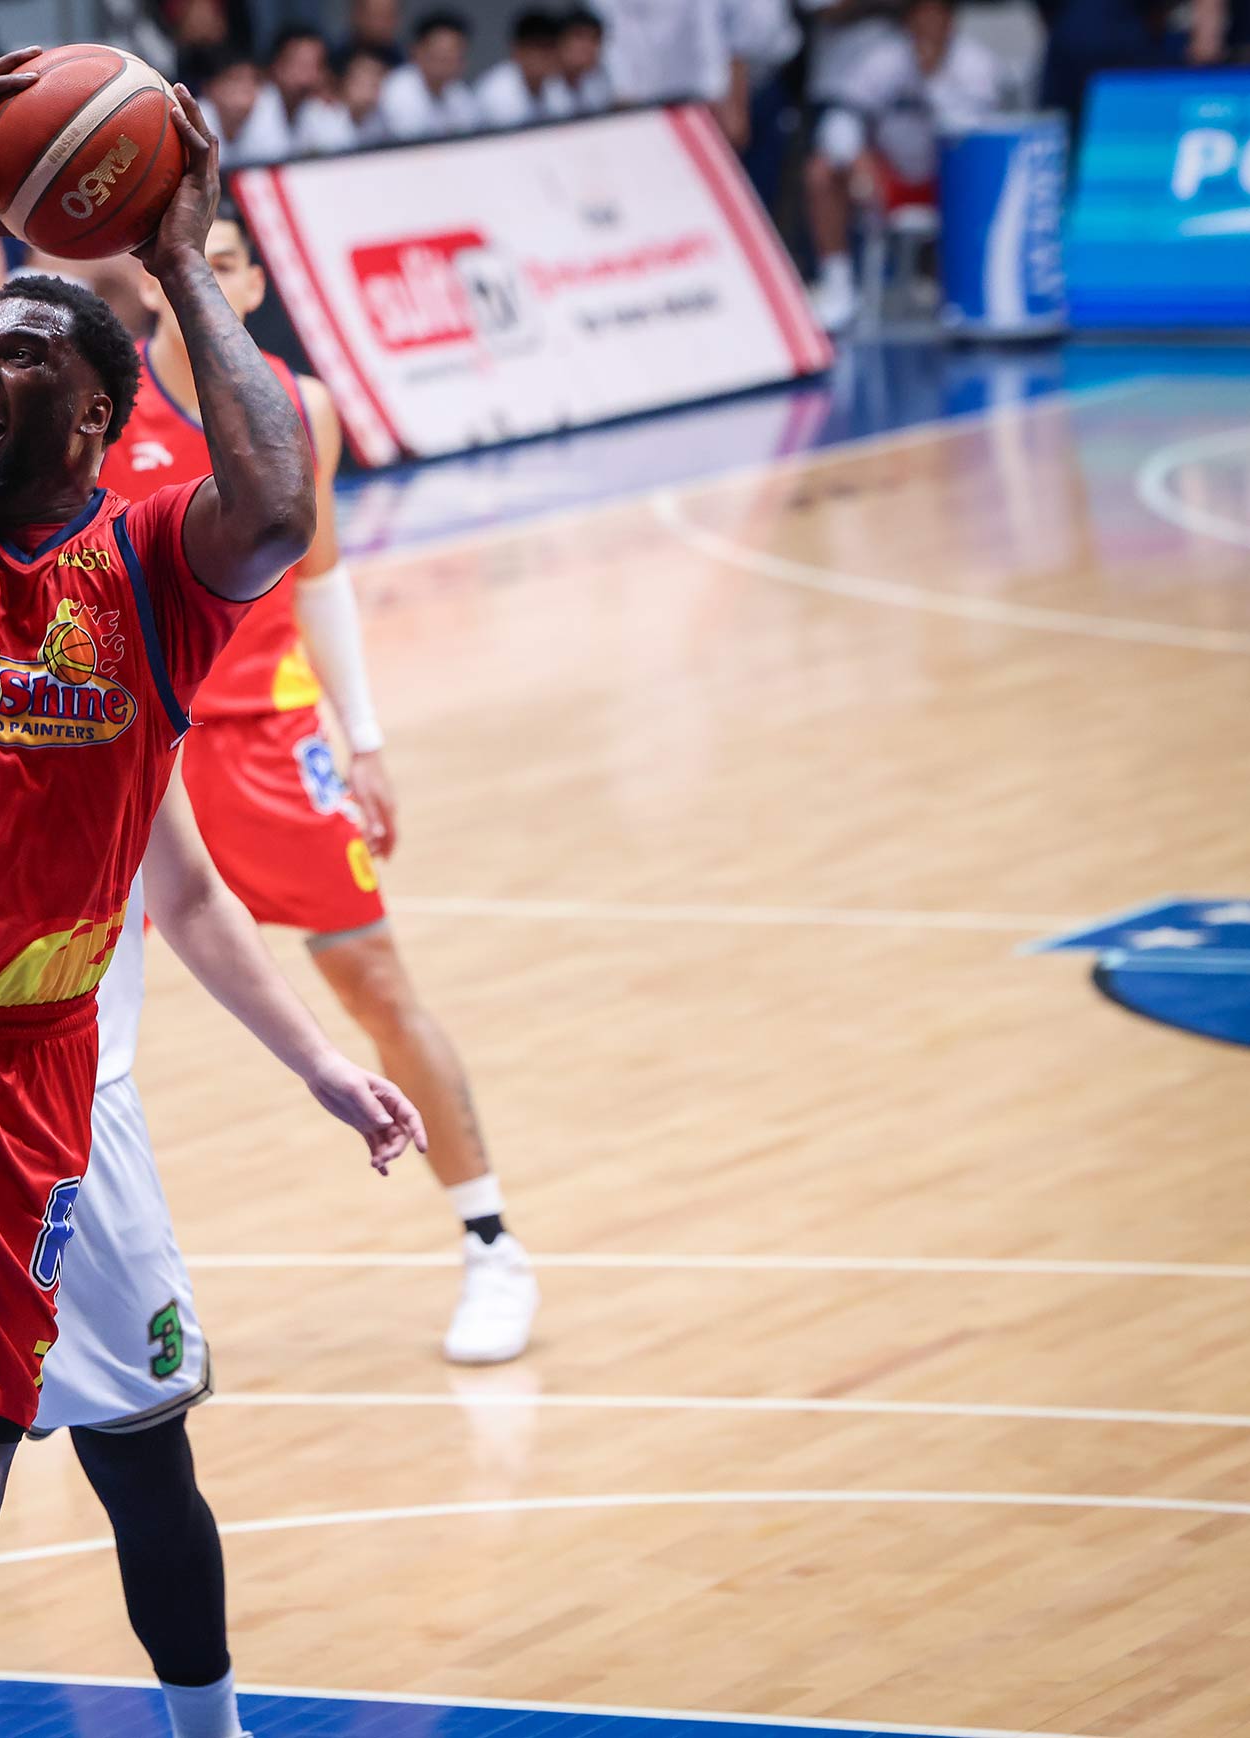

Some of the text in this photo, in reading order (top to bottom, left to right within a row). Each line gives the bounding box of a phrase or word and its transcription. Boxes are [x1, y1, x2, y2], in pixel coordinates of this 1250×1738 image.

[1171, 127, 1250, 201] P
[9, 721, 95, 740] PAINTERS
[147, 1298, 184, 1383] 3
